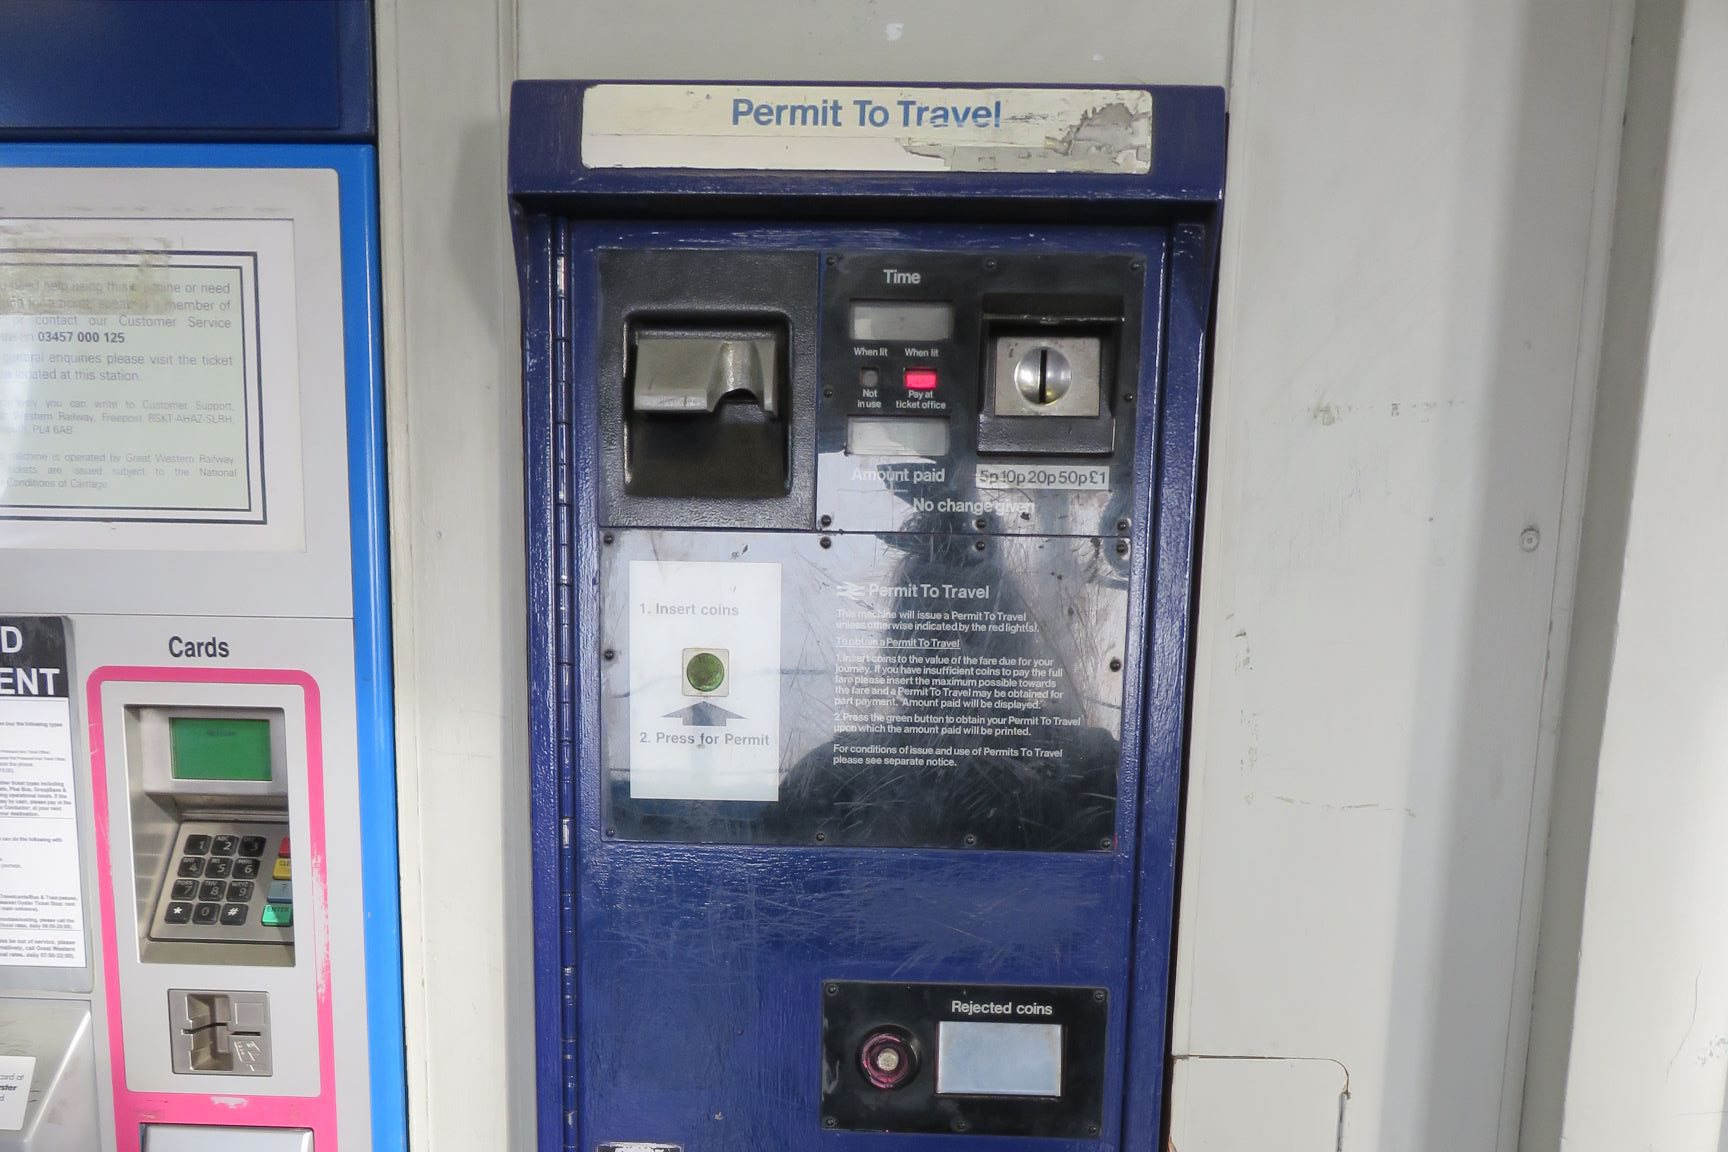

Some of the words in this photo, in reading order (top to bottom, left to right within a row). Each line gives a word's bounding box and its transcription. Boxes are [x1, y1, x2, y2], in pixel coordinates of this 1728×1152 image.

[732, 98, 842, 127] Permit
[853, 100, 890, 128] To
[897, 100, 1001, 128] Travel
[883, 269, 921, 284] Time
[185, 285, 196, 293] or
[201, 283, 230, 294] need
[219, 300, 231, 311] of
[36, 316, 78, 326] contact
[89, 318, 106, 326] our
[119, 315, 176, 327] Customer
[188, 316, 232, 328] Service
[38, 332, 73, 342] 03457
[78, 332, 99, 342] 000
[104, 332, 125, 343] 125
[854, 348, 877, 356] When
[880, 348, 888, 356] lit
[905, 348, 928, 357] When
[931, 348, 939, 357] lit
[107, 353, 145, 365] please
[150, 355, 173, 365] visit
[178, 354, 196, 365] the
[202, 356, 232, 366] ticket
[60, 370, 70, 379] at
[75, 369, 96, 380] this
[863, 389, 877, 398] Not
[908, 390, 923, 400] Pay
[143, 400, 188, 409] Customer
[858, 400, 864, 408] in
[896, 400, 920, 408] ticket
[922, 400, 946, 409] office
[200, 468, 236, 477] National
[852, 467, 909, 481] Amount
[914, 468, 945, 484] paid
[980, 470, 998, 485] 5p
[1002, 470, 1025, 485] 10p
[1028, 470, 1056, 486] 20p
[1058, 471, 1087, 486] 50p
[1089, 471, 1105, 484] £1
[913, 498, 934, 512] No
[937, 498, 992, 515] change
[995, 500, 1035, 516] given
[870, 583, 918, 598] Permit
[920, 584, 940, 598] To
[942, 584, 989, 598] Travel
[640, 603, 652, 614] 1.
[656, 603, 695, 615] Insert
[701, 604, 739, 616] coins
[900, 610, 914, 619] will
[918, 610, 942, 620] issue
[952, 611, 982, 620] Permit
[984, 612, 995, 620] To
[998, 612, 1026, 621] Travel
[915, 622, 957, 631] indicated
[959, 622, 969, 632] by
[972, 623, 986, 631] the
[989, 623, 1004, 632] red
[1006, 622, 1040, 634] light(s).
[168, 636, 230, 658] Cards
[887, 638, 916, 647] Permit
[918, 639, 930, 647] To
[931, 639, 960, 648] Travel
[909, 655, 923, 663] the
[925, 655, 949, 664] value
[951, 656, 962, 664] of
[964, 656, 978, 665] the
[980, 656, 997, 665] fare
[999, 657, 1016, 665] due
[1018, 657, 1032, 666] for
[1033, 659, 1054, 667] your
[882, 666, 898, 675] you
[900, 665, 922, 674] have
[923, 665, 974, 675] insufficient
[976, 666, 1001, 675] coins
[1013, 668, 1030, 678] pay
[1032, 668, 1047, 676] the
[1048, 668, 1063, 677] full
[855, 676, 885, 686] please
[887, 676, 913, 685] insert
[915, 677, 930, 685] the
[932, 678, 976, 687] maximum
[978, 679, 1017, 689] possible
[1019, 679, 1056, 688] towards
[851, 686, 869, 695] fare
[871, 686, 889, 695] and
[897, 687, 928, 696] Permit
[929, 687, 941, 696] To
[943, 688, 971, 697] Travel
[972, 690, 992, 699] may
[994, 689, 1006, 698] be
[1008, 690, 1048, 698] obtained
[1050, 690, 1064, 699] for
[855, 698, 898, 707] payment.
[902, 698, 939, 707] Amount
[941, 699, 961, 708] paid
[963, 699, 979, 708] will
[980, 700, 992, 708] be
[994, 700, 1041, 710] displayed.
[870, 712, 884, 721] the
[886, 715, 912, 724] green
[914, 714, 944, 723] button
[956, 715, 985, 724] obtain
[987, 717, 1007, 726] your
[1008, 716, 1038, 725] Permit
[1040, 717, 1051, 725] To
[1053, 717, 1081, 726] Travel
[834, 725, 856, 733] upon
[859, 724, 885, 733] which
[887, 724, 902, 733] the
[904, 725, 939, 734] amount
[941, 726, 961, 735] paid
[963, 726, 979, 734] will
[981, 726, 992, 735] be
[995, 727, 1031, 736] printed.
[640, 732, 652, 743] 2.
[656, 732, 695, 744] Press
[700, 732, 720, 745] for
[725, 733, 769, 746] Permit
[833, 744, 848, 753] For
[850, 745, 897, 754] conditions
[899, 745, 908, 754] of
[910, 746, 933, 755] issue
[935, 746, 952, 755] and
[954, 748, 970, 756] use
[972, 747, 981, 756] of
[984, 747, 1019, 756] Permits
[1020, 748, 1032, 757] To
[1034, 748, 1063, 757] Travel
[833, 755, 863, 765] please
[884, 757, 924, 766] separate
[926, 757, 957, 766] notice.
[952, 1000, 1012, 1015] Rejected
[1016, 1002, 1053, 1015] coins
